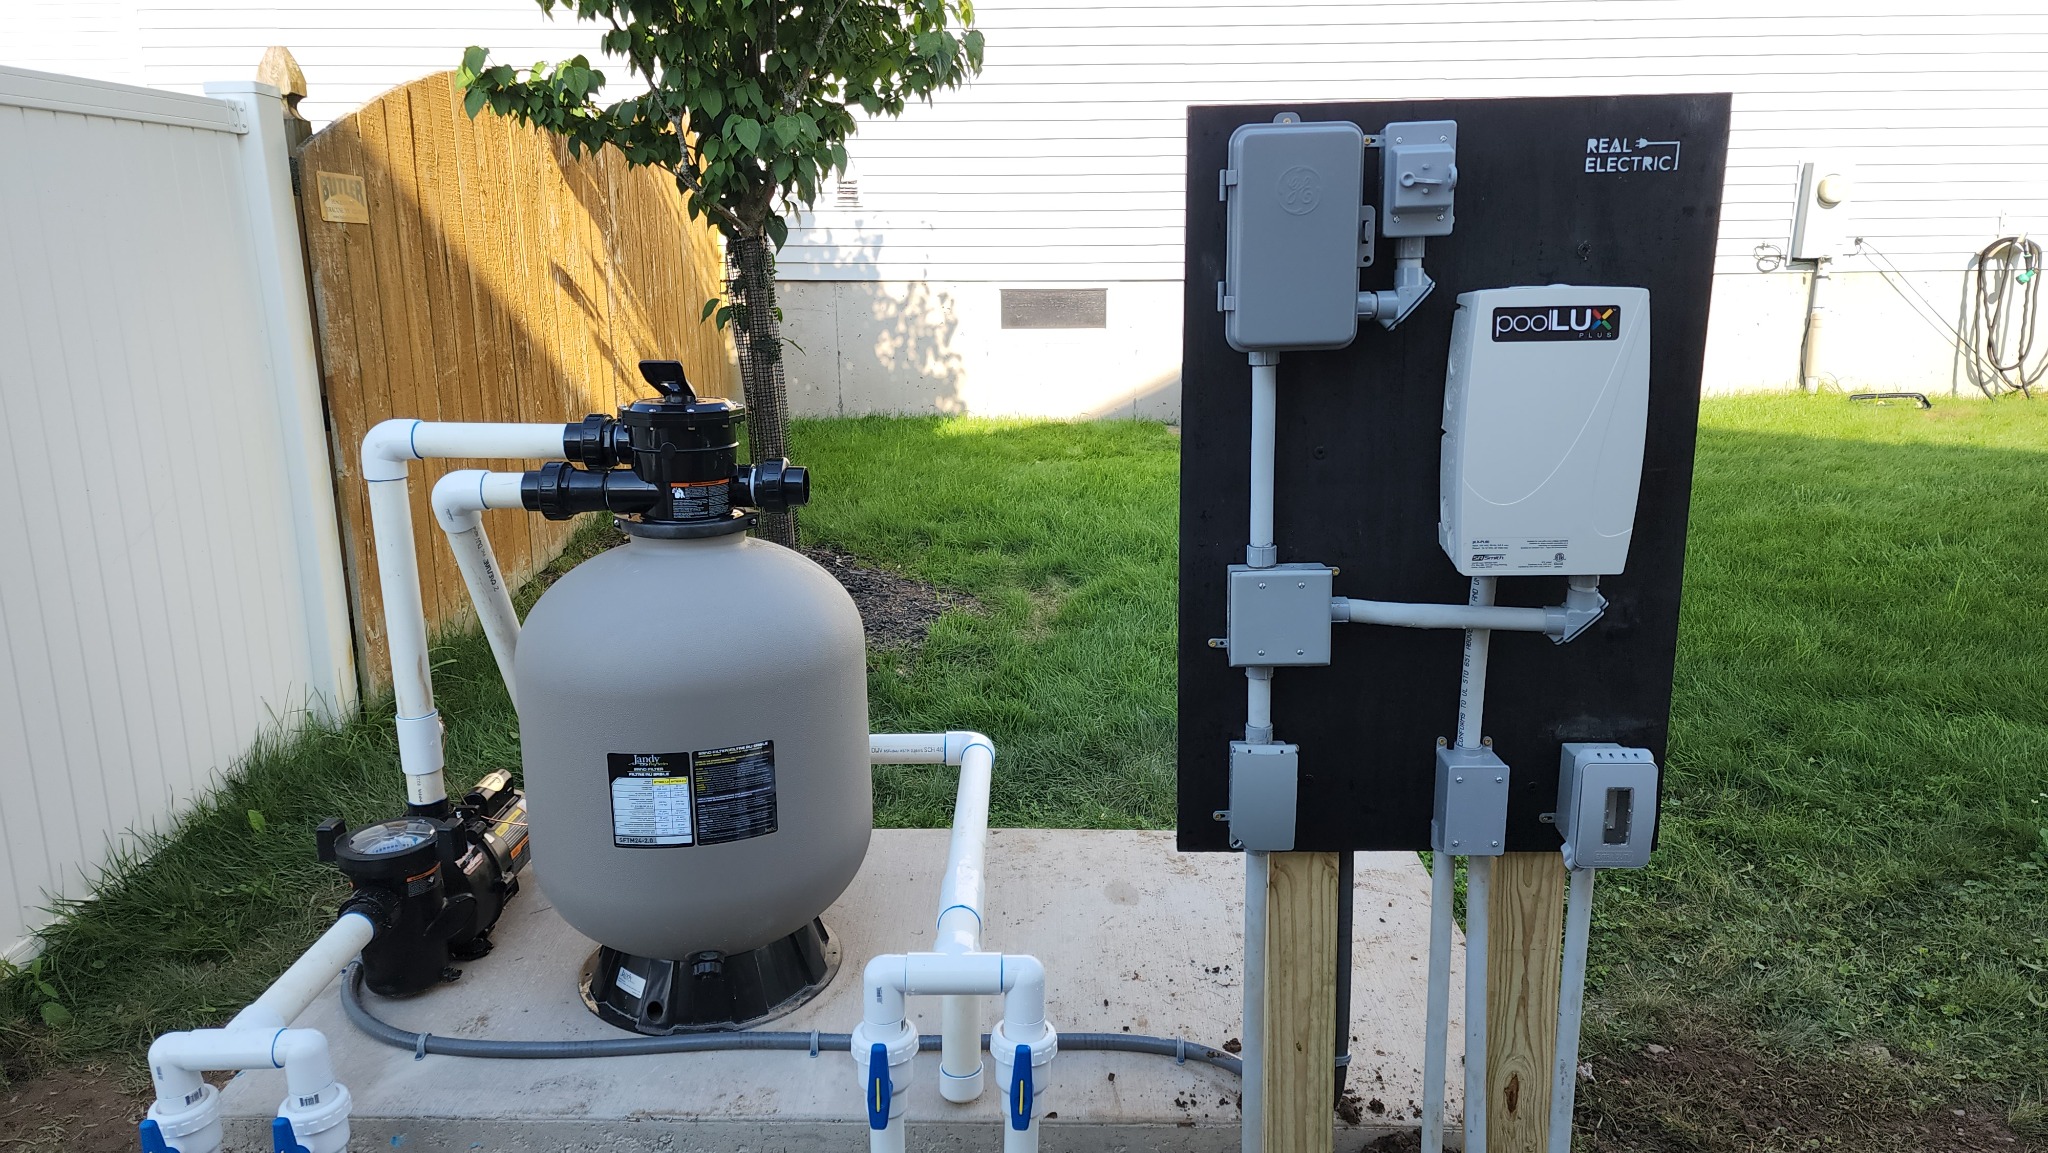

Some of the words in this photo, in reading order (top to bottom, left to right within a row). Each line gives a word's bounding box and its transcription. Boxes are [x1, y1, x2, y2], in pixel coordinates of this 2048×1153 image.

[1586, 137, 1633, 154] REAL
[1584, 155, 1672, 173] ELECTRIC
[1495, 308, 1614, 338] poolLUX
[1471, 588, 1479, 603] AND
[1462, 688, 1468, 697] UL
[1460, 699, 1467, 709] TO
[633, 754, 661, 766] Jandy
